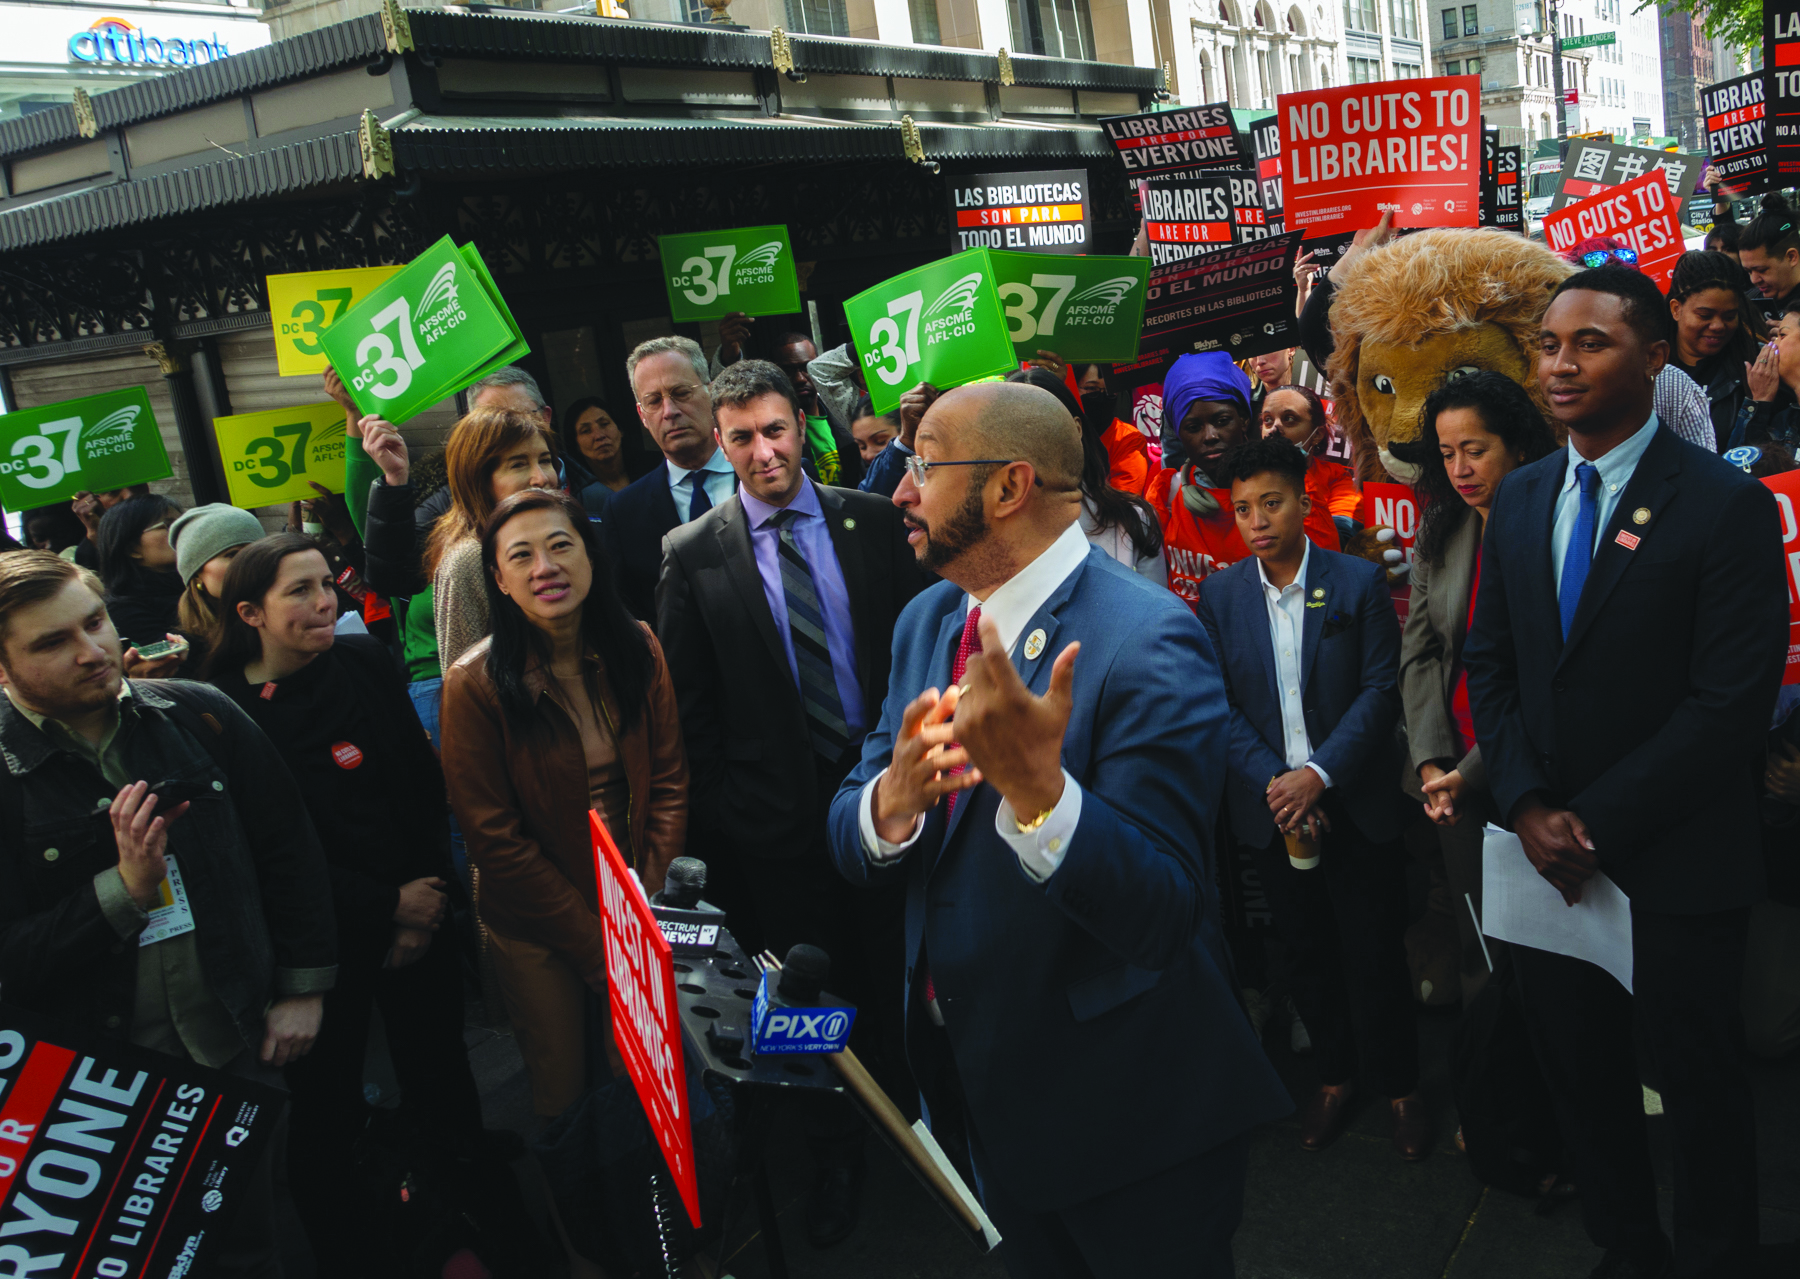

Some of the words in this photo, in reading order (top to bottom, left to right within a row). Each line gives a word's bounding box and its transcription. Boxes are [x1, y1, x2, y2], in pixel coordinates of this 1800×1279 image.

[1775, 12, 1800, 39] LA
[69, 25, 229, 64] citibank
[1563, 35, 1582, 46] STEVE
[1584, 32, 1616, 43] FLANDERS
[1704, 77, 1765, 117] LIBRAR
[1775, 70, 1800, 98] TO
[1107, 107, 1228, 139] LIBRARIES
[1289, 101, 1330, 142] NO
[1341, 91, 1422, 135] CUTS
[1430, 88, 1470, 128] TO
[1723, 109, 1747, 127] ARE
[1140, 134, 1169, 146] ARE
[1178, 129, 1208, 140] FOR
[1709, 119, 1766, 157] EVERY
[1776, 125, 1788, 136] NO
[1790, 124, 1798, 136] A
[1120, 136, 1239, 169] EVERYONE
[1291, 133, 1469, 185] LIBRARIES!
[1727, 159, 1750, 173] CUTS
[1750, 155, 1763, 167] TO
[954, 187, 984, 207] LAS
[987, 182, 1082, 206] BIBLIOTECAS
[1142, 187, 1229, 221] LIBRARIES
[981, 209, 1012, 224] SON
[1020, 206, 1061, 222] PARA
[1235, 209, 1264, 223] ARE
[1295, 205, 1352, 219] INVESTINLIBRARIES.ORG
[1496, 212, 1519, 223] ARIES
[1549, 217, 1576, 251] NO
[1578, 195, 1632, 239] CUTS
[1632, 181, 1665, 217] TO
[1691, 211, 1705, 219] City
[958, 229, 1001, 250] TODO
[1005, 227, 1026, 248] EL
[1029, 224, 1086, 246] MUNDO
[1160, 226, 1179, 239] ARE
[1186, 225, 1209, 240] FOR
[1612, 215, 1676, 256] RIES!
[1150, 243, 1232, 266] EVERY
[1150, 236, 1292, 279] BIBLIOTECAS
[672, 276, 690, 288] DC
[681, 244, 737, 305] 37
[735, 266, 773, 277] AFSCME
[736, 275, 775, 286] AFL-CIO
[1151, 273, 1179, 287] ON
[1194, 255, 1252, 275] PARA
[1169, 280, 1196, 295] EL
[1202, 256, 1285, 288] MUNDO
[419, 299, 461, 335] AFSCME
[999, 273, 1077, 343] 37
[1066, 305, 1117, 315] AFSCME
[1146, 308, 1193, 328] RECORTES
[1194, 305, 1207, 315] EN
[1208, 300, 1225, 312] LAS
[1227, 286, 1283, 307] BIBLIOTECAS
[281, 322, 300, 335] DC
[291, 287, 353, 356] 37
[425, 310, 467, 346] AFL-CIO
[924, 309, 973, 335] AFSCME
[1065, 315, 1115, 326] AFL-CIO
[870, 289, 924, 386] 37
[927, 322, 976, 346] AFL-CIO
[355, 296, 427, 400] 37
[864, 349, 881, 368] DC
[352, 368, 374, 392] DC
[10, 416, 84, 489] 37
[85, 432, 132, 450] AFSCME
[88, 442, 135, 459] AFL-CIO
[312, 441, 345, 455] AFSCM
[0, 459, 26, 474] DC
[233, 458, 256, 472] DC
[244, 421, 313, 488] 37
[314, 448, 346, 463] AFL-C
[1375, 497, 1415, 539] NO
[170, 869, 188, 914] PRESS
[141, 934, 155, 943] ESS
[169, 922, 193, 933] PRESS
[597, 846, 646, 986] INVEST
[646, 937, 668, 1032] IN
[656, 920, 700, 933] PECTRUM
[661, 930, 698, 945] NEWS
[709, 934, 714, 942] 1
[604, 915, 680, 1119] LIBRARIES
[764, 1015, 825, 1039] PIX
[804, 1043, 822, 1051] VERY
[0, 1056, 149, 1279] RYONE
[110, 1084, 205, 1246] LIBRARIES
